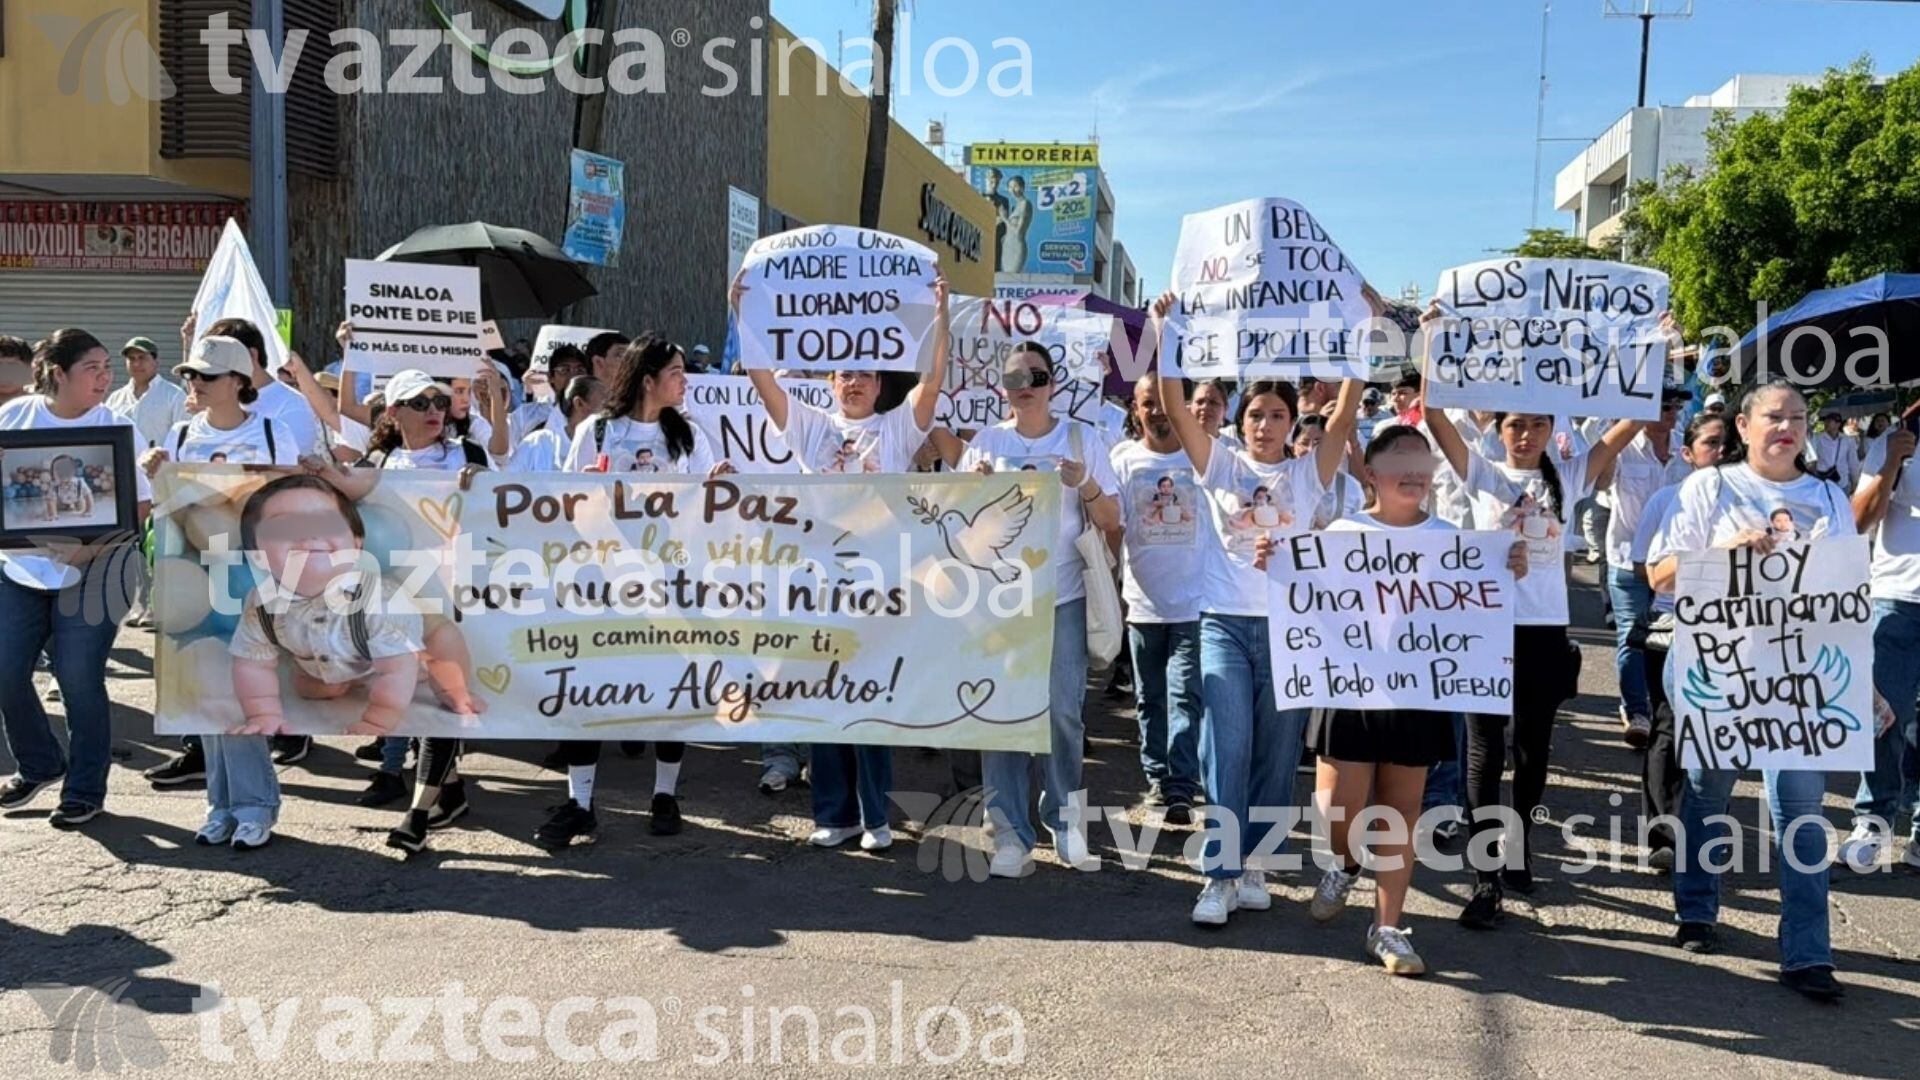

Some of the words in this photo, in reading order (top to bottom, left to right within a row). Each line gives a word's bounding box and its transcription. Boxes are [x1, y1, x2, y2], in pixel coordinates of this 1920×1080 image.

[976, 144, 1093, 161] TINTORERÍA
[857, 231, 905, 250] UNA
[1224, 209, 1251, 246] UN
[1271, 206, 1333, 246] BEB
[763, 255, 848, 280] MADRE
[858, 254, 922, 278] LLORA
[1246, 251, 1267, 268] SE
[1280, 245, 1355, 275] TOCA
[369, 283, 454, 303] SINALOA
[1180, 291, 1206, 316] LA
[1225, 279, 1344, 311] INFANCIA
[1452, 260, 1527, 308] LOS
[350, 304, 413, 321] PONTE
[417, 308, 442, 323] DE
[447, 310, 478, 325] PIE
[775, 289, 900, 317] LLORAMOS
[981, 299, 1042, 337] NO
[350, 341, 369, 351] NO
[372, 340, 399, 353] MÁS
[402, 344, 420, 354] DE
[421, 345, 438, 355] LO
[441, 346, 482, 357] MISMO
[766, 326, 905, 362] TODAS
[1436, 350, 1527, 388] crecer
[1535, 354, 1573, 385] en
[1580, 342, 1654, 400] PAZ
[737, 386, 765, 406] LO
[492, 483, 589, 528] Por
[613, 480, 679, 521] La
[702, 480, 814, 533] Paz,
[542, 537, 622, 577] por
[641, 523, 684, 565] la
[1344, 532, 1426, 576] dolor
[1440, 535, 1485, 571] de
[453, 579, 533, 624] por
[555, 568, 767, 612] nuestros
[787, 577, 908, 617] niños
[1288, 581, 1364, 614] Una
[1375, 579, 1503, 615] MADRE
[527, 627, 579, 658] Hoy
[592, 625, 741, 650] caminamos
[753, 630, 799, 655] por
[811, 627, 840, 657] ti,
[1285, 625, 1323, 651] es
[1343, 620, 1373, 651] el
[1397, 621, 1486, 654] dolor
[1768, 620, 1806, 673] ti
[538, 666, 655, 718] Juan
[666, 656, 905, 724] Alejandro!
[1284, 663, 1315, 699] de
[1318, 656, 1375, 698] todo
[1386, 671, 1418, 691] un
[1727, 665, 1825, 711] Juan
[1675, 704, 1848, 771] Alejandro
